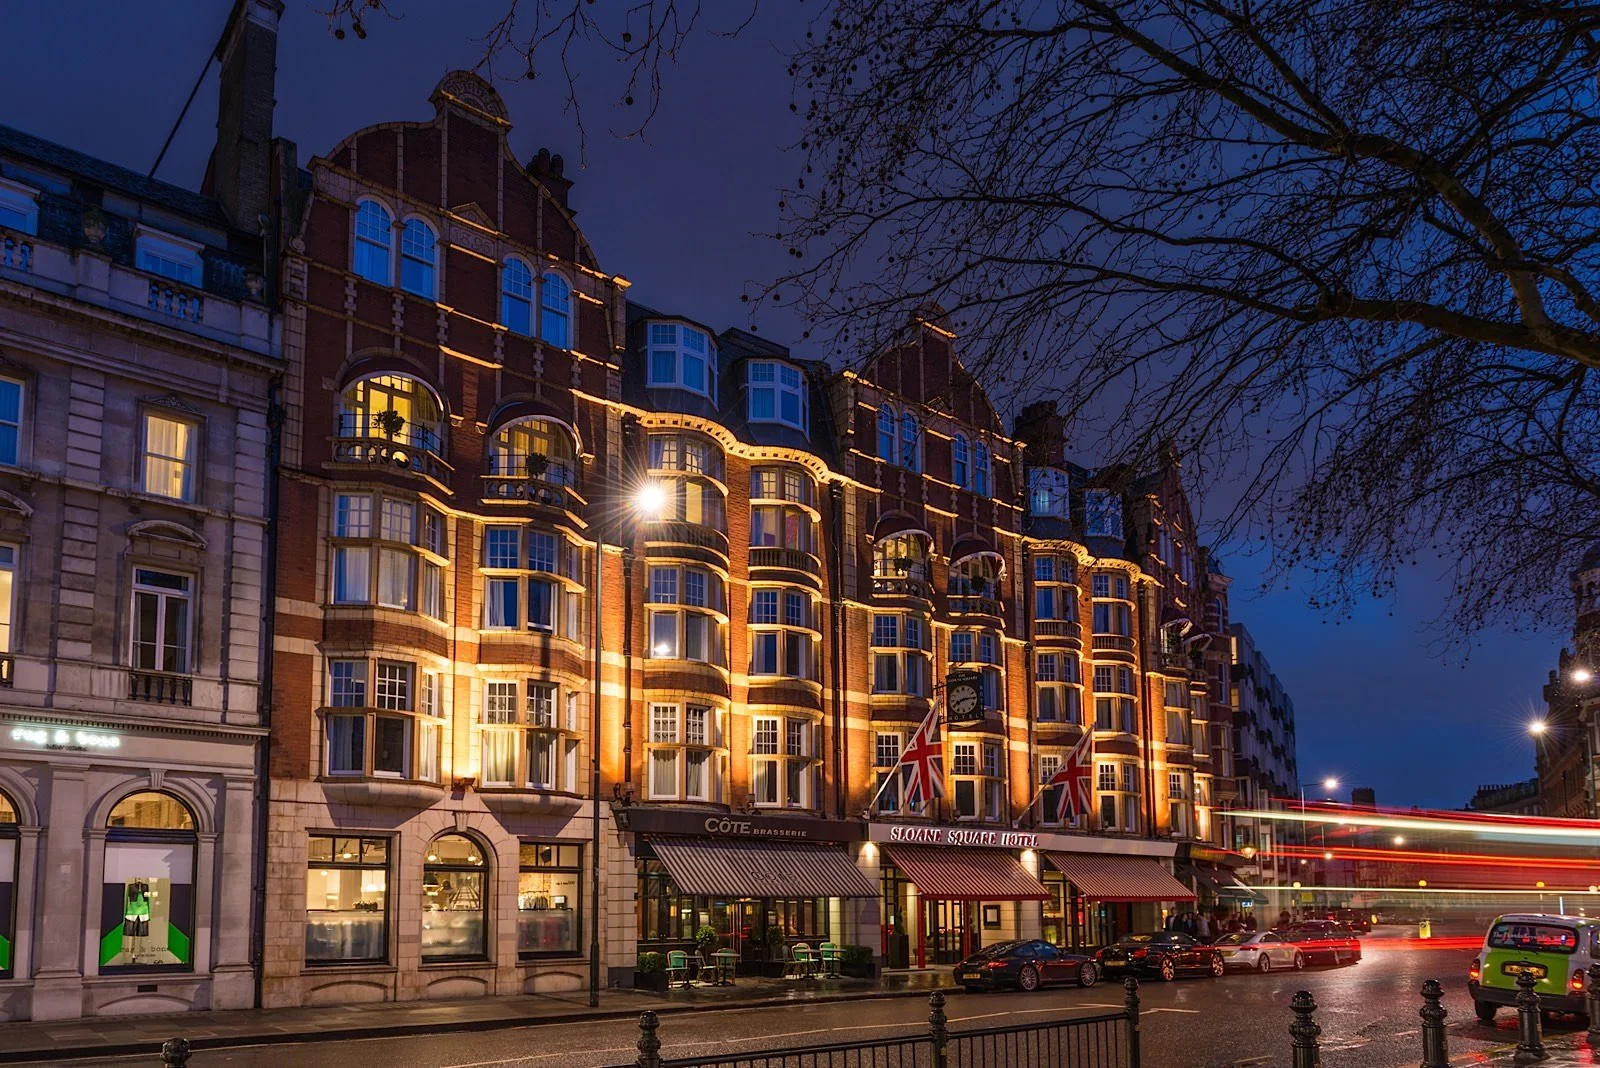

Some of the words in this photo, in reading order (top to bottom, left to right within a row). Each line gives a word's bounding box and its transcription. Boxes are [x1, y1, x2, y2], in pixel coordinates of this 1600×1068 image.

[704, 816, 751, 834] CÔTE
[753, 828, 807, 838] BRASSERIE
[890, 826, 942, 842] SLOANE
[948, 829, 997, 846] SQUARE
[1001, 832, 1039, 848] HOTEL
